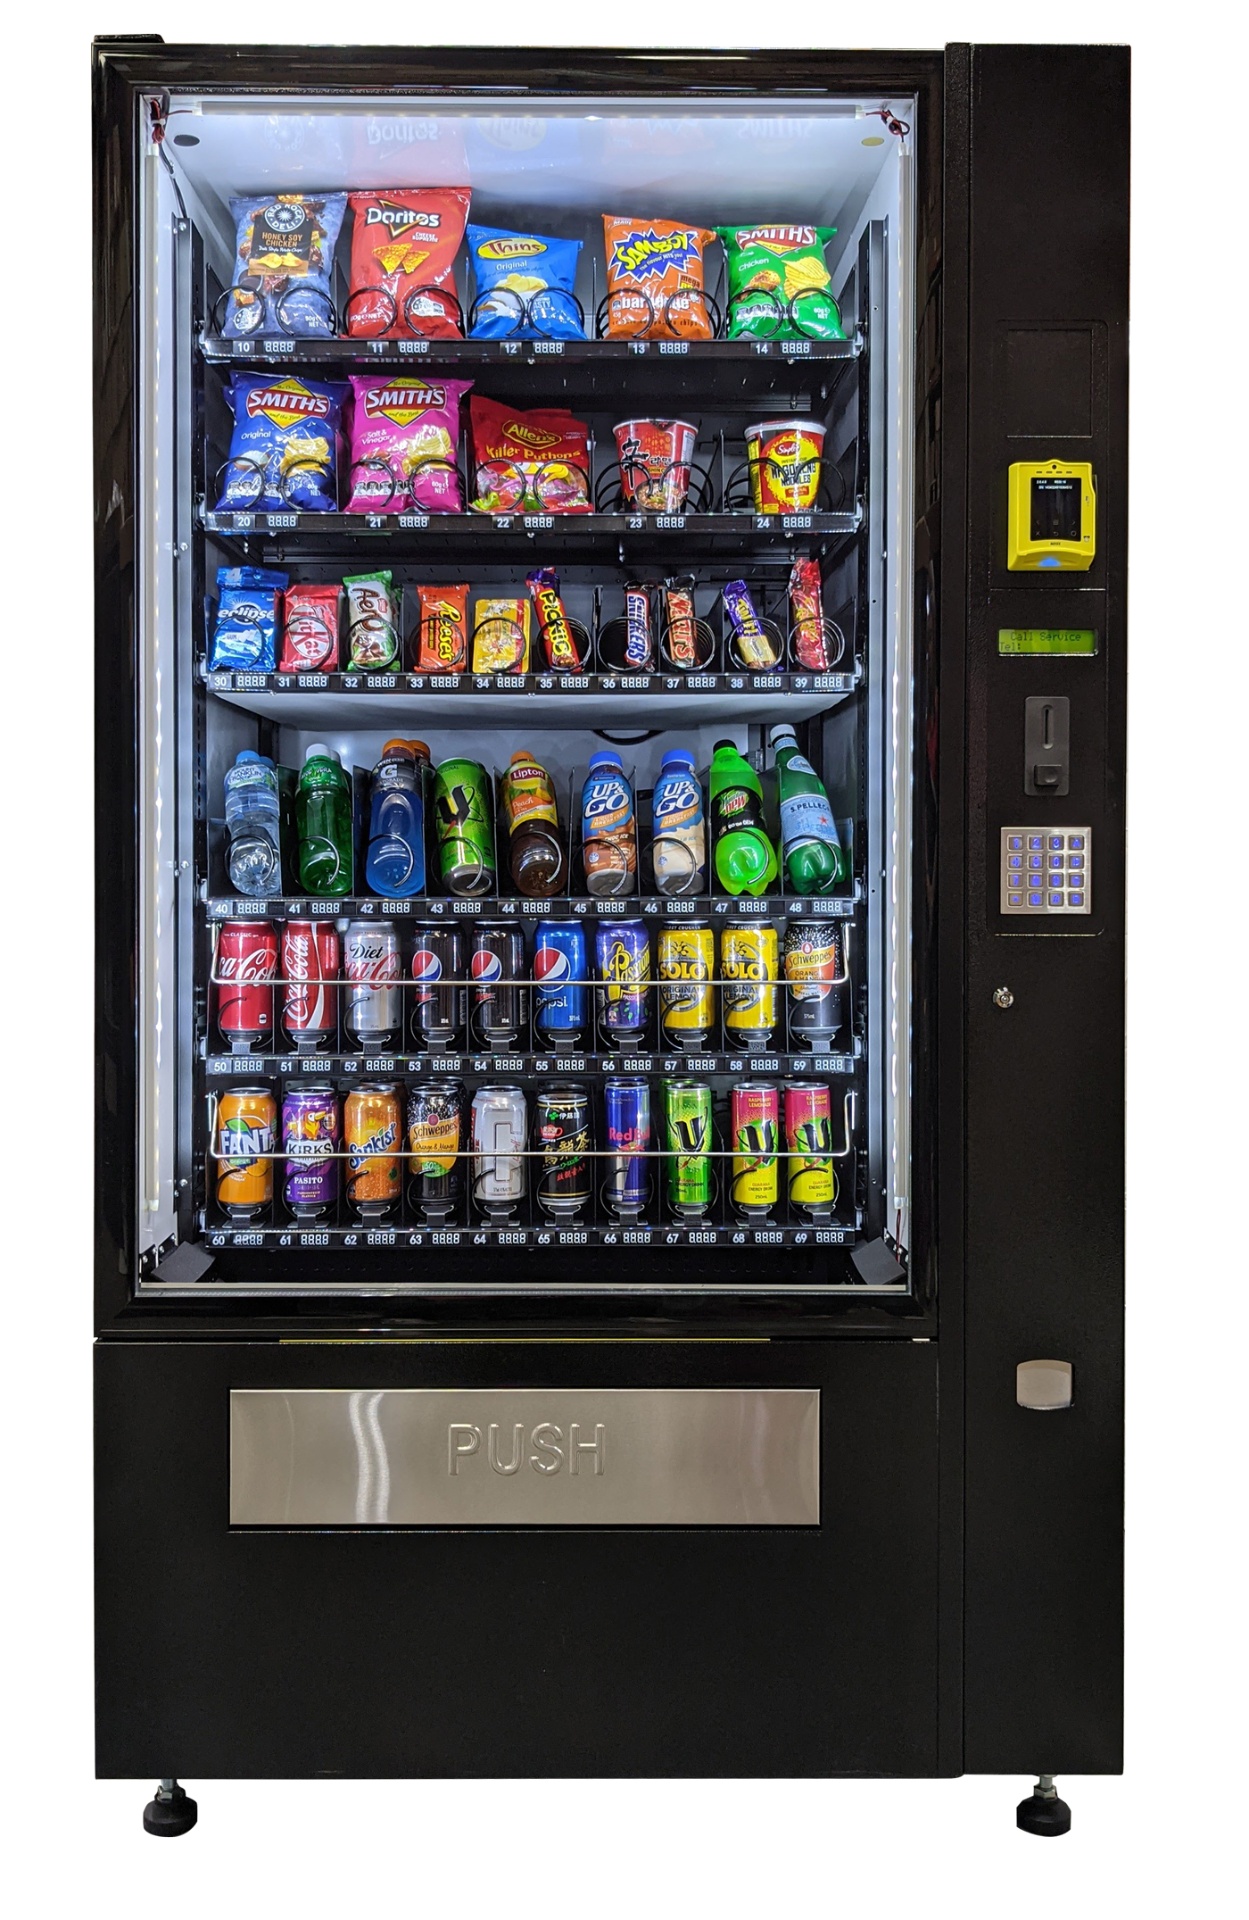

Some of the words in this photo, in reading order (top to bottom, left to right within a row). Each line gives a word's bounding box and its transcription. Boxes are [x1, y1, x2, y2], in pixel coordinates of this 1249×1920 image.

[367, 208, 439, 227] Doritos
[272, 221, 297, 230] DELI
[262, 232, 286, 240] HONEY
[288, 234, 303, 242] SOY
[266, 240, 298, 248] CHICKEN
[482, 239, 542, 256] Thins
[617, 233, 688, 270] SAMBOY
[496, 260, 528, 271] Original
[238, 343, 250, 352] 10
[372, 343, 382, 353] 11
[505, 344, 517, 353] 12
[633, 344, 645, 353] 13
[756, 344, 768, 353] 14
[366, 388, 444, 409] SMITH'S
[241, 430, 271, 440] Original
[367, 430, 380, 439] Salt
[508, 424, 555, 442] Allen's
[362, 435, 391, 446] Vinegar
[486, 444, 520, 459] Killer
[524, 448, 581, 460] Pythons
[238, 517, 250, 527] 20
[370, 518, 381, 527] 21
[497, 518, 509, 528] 22
[630, 519, 642, 528] 23
[757, 518, 770, 528] 24
[218, 603, 274, 622] eclipse
[352, 587, 384, 632] Aero
[437, 600, 462, 662] Reese's
[1010, 632, 1033, 641] Call
[1040, 631, 1082, 642] Service
[1000, 642, 1021, 651] Tel:
[214, 677, 226, 686] 30
[279, 678, 290, 687] 31
[345, 678, 358, 688] 32
[410, 679, 423, 688] 33
[476, 679, 489, 688] 34
[540, 679, 552, 688] 35
[603, 679, 616, 688] 36
[667, 679, 680, 688] 37
[730, 679, 743, 688] 38
[795, 679, 807, 688] 39
[381, 764, 398, 779] G
[512, 768, 544, 780] Lipton
[512, 794, 534, 808] Peach
[585, 792, 629, 818] GO
[655, 791, 700, 817] GO
[216, 904, 228, 913] 40
[289, 904, 300, 913] 41
[360, 904, 374, 913] 42
[430, 904, 444, 913] 43
[502, 904, 514, 913] 44
[574, 904, 586, 913] 45
[644, 904, 658, 913] 46
[715, 903, 728, 913] 47
[789, 903, 802, 913] 48
[350, 943, 384, 959] Diet
[788, 950, 832, 969] Schweppes
[660, 962, 706, 980] SOLO
[721, 962, 764, 980] SOLO
[214, 1062, 226, 1072] 50
[280, 1062, 292, 1072] 51
[344, 1062, 357, 1071] 52
[408, 1062, 421, 1071] 53
[474, 1061, 487, 1071] 54
[536, 1061, 548, 1071] 55
[602, 1061, 615, 1071] 56
[664, 1061, 677, 1071] 57
[730, 1061, 742, 1071] 58
[793, 1061, 806, 1071] 59
[412, 1121, 458, 1140] Schweppes
[609, 1127, 632, 1141] Red
[288, 1142, 333, 1154] KIRKS
[349, 1122, 397, 1170] Sunkist
[416, 1143, 433, 1151] Orange
[294, 1176, 323, 1185] PASITO
[212, 1236, 225, 1245] 60
[280, 1236, 291, 1245] 61
[344, 1236, 357, 1245] 62
[410, 1236, 422, 1245] 63
[474, 1235, 486, 1244] 64
[538, 1235, 550, 1244] 65
[604, 1234, 616, 1244] 66
[666, 1234, 679, 1244] 67
[732, 1234, 745, 1243] 68
[794, 1234, 808, 1243] 69
[448, 1422, 606, 1477] PUSH
